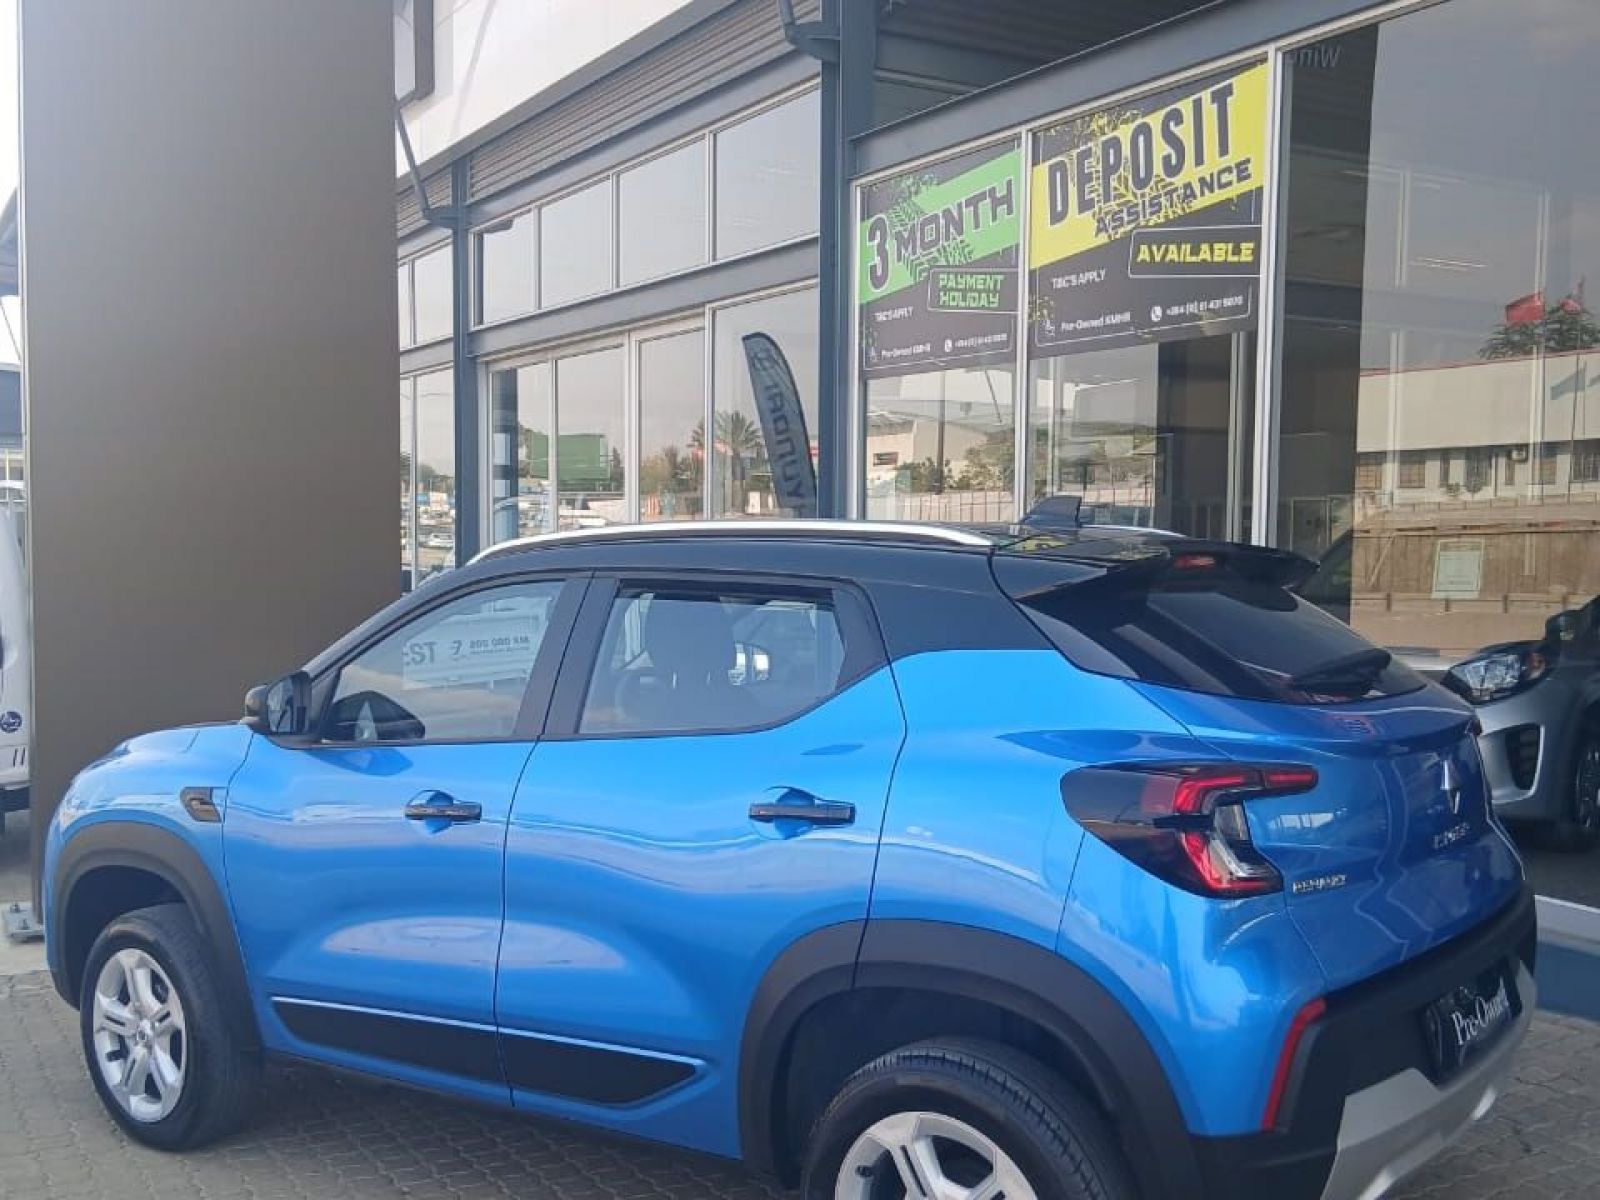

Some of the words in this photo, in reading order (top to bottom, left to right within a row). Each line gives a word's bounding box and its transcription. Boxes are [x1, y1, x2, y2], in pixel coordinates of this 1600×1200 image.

[1048, 80, 1235, 228] DEPOSIT
[1094, 157, 1253, 238] ASSISTANCE
[868, 216, 890, 291] 3
[894, 178, 1015, 265] MONTH
[1136, 241, 1256, 264] AVAILABLE
[938, 273, 1005, 291] PAYMENT
[1078, 268, 1106, 286] APPLY
[938, 290, 1001, 309] HOLIDAY
